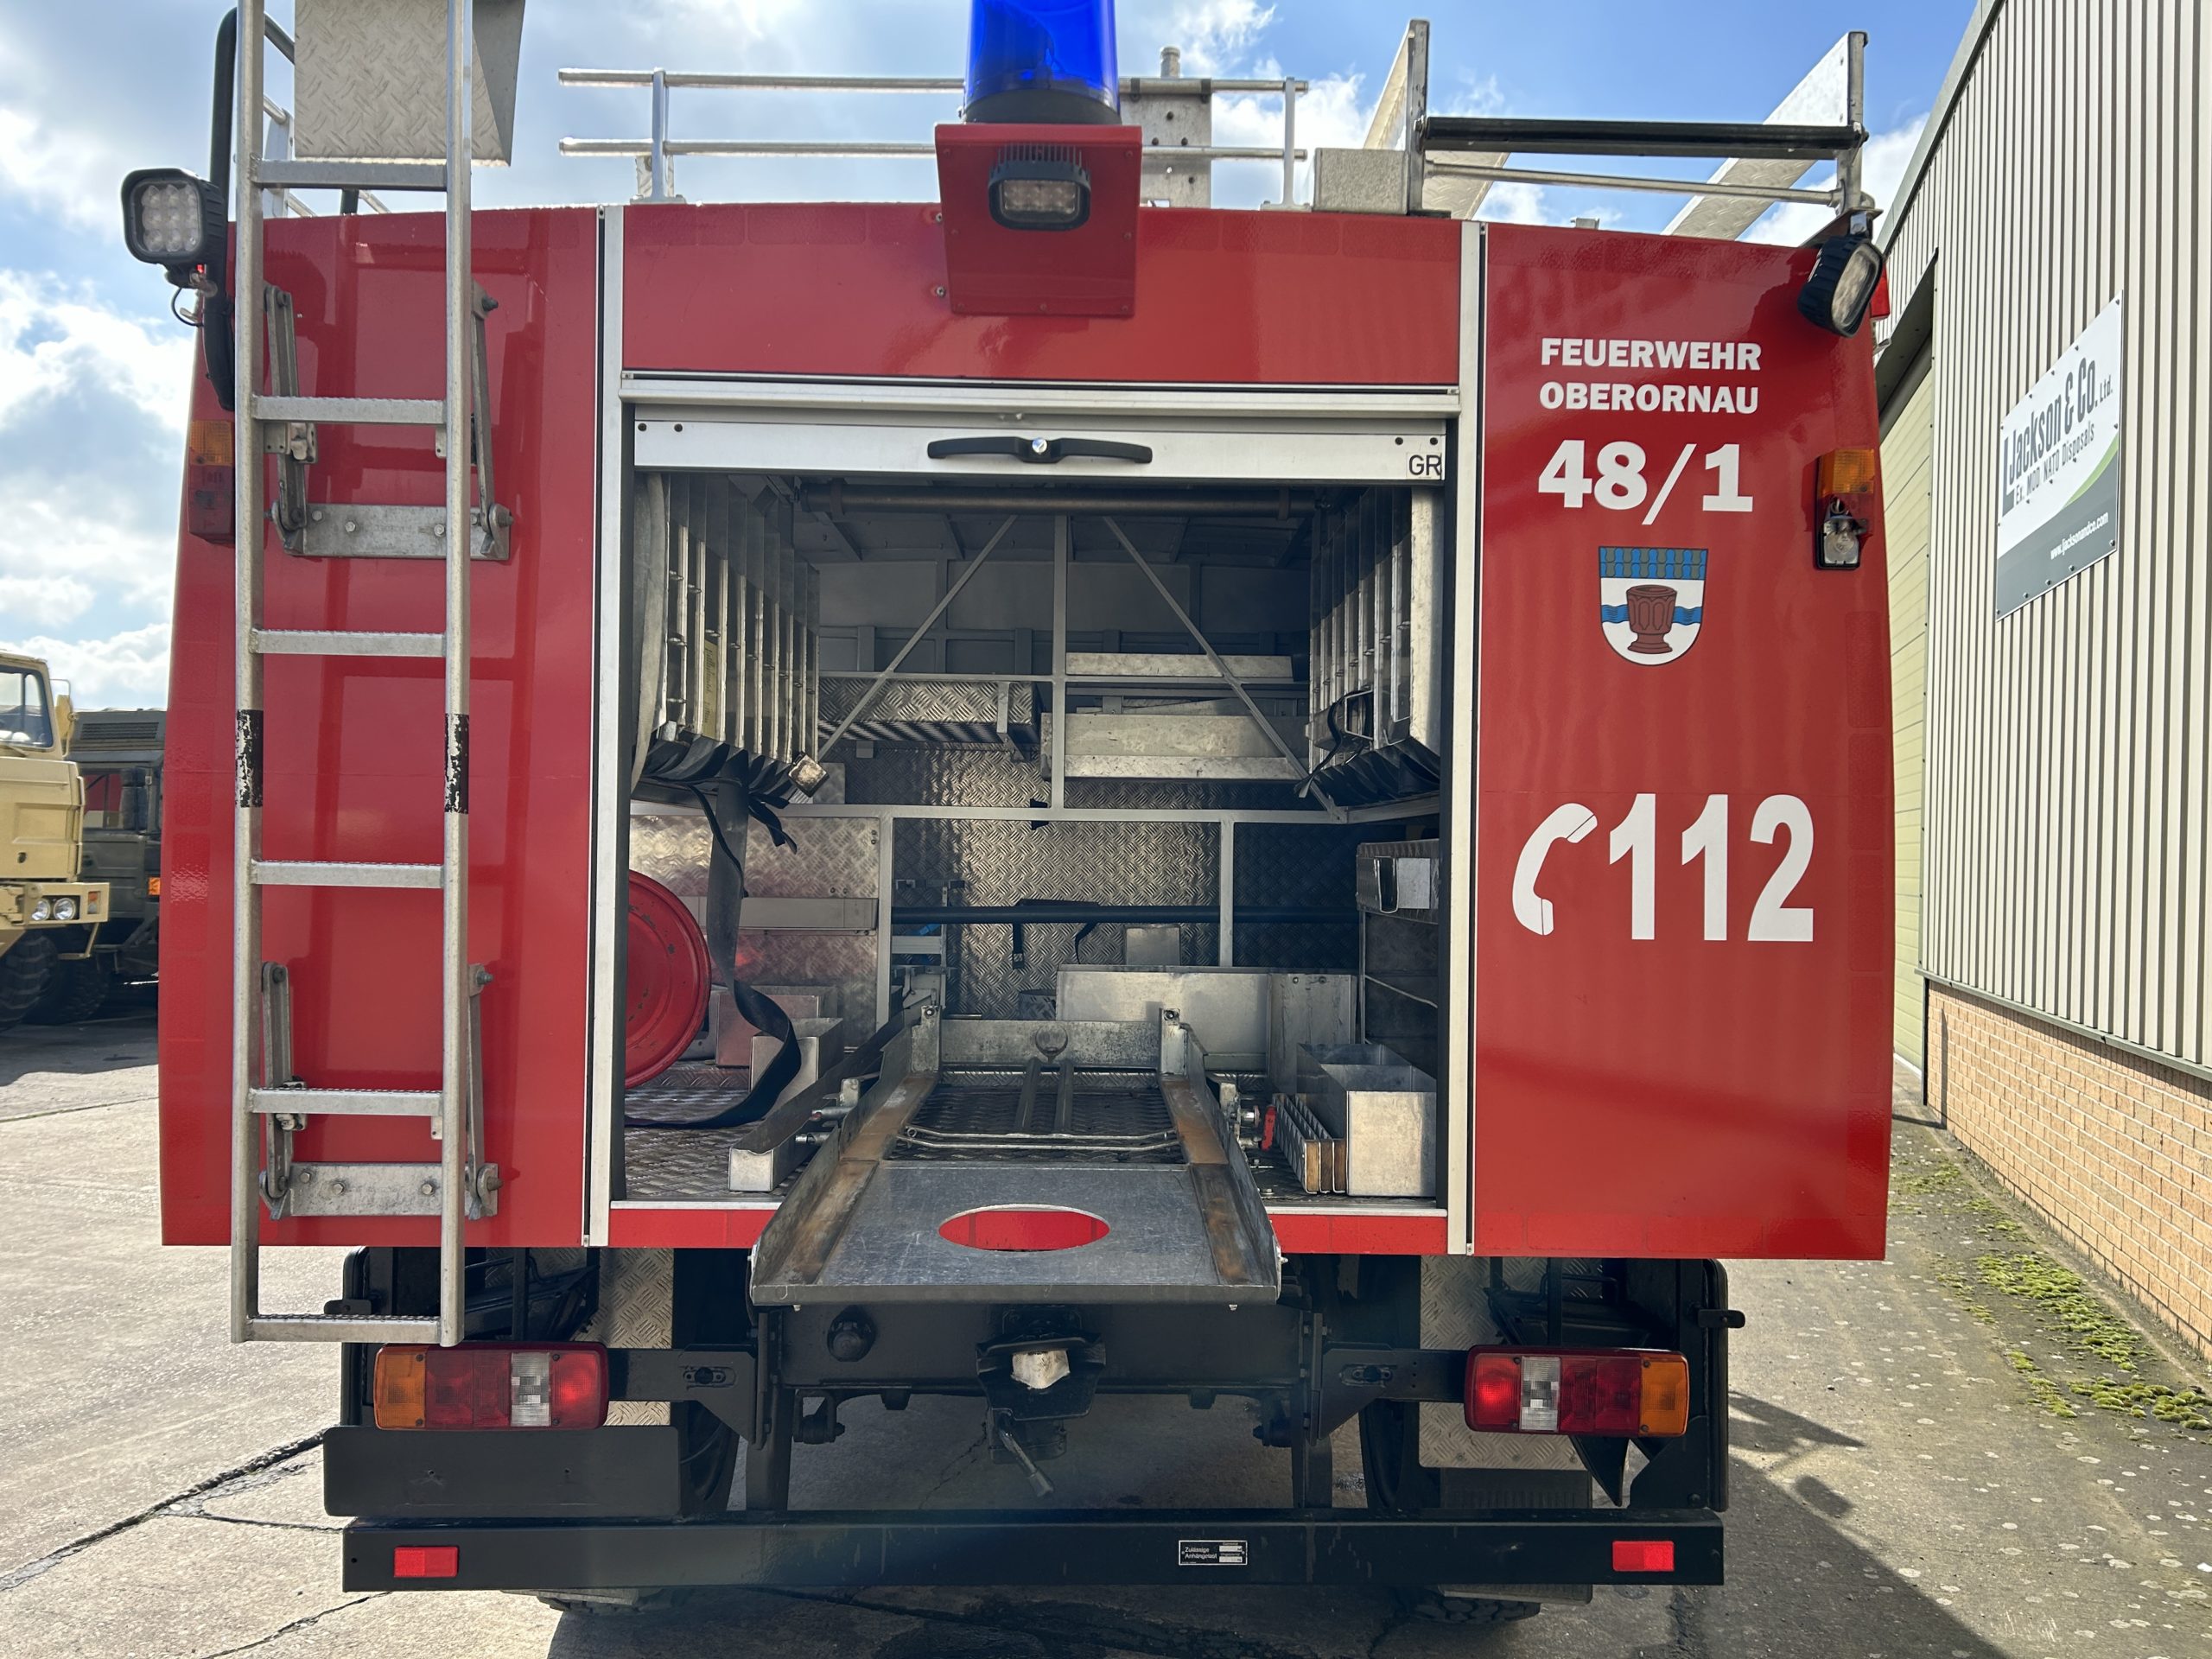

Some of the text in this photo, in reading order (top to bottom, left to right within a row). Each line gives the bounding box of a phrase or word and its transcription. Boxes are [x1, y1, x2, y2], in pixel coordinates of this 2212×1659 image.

[1541, 338, 1763, 371] FEUERWEHR
[1539, 381, 1759, 414] OBERORNAU
[2009, 358, 2113, 486] Jackson & Co. Ltd.
[1408, 454, 1442, 476] GR
[1538, 439, 1754, 525] 48/1
[2026, 467, 2041, 496] MOD
[2044, 448, 2060, 482] NATO
[2062, 420, 2094, 467] Disposals
[1609, 793, 1815, 942] 112
